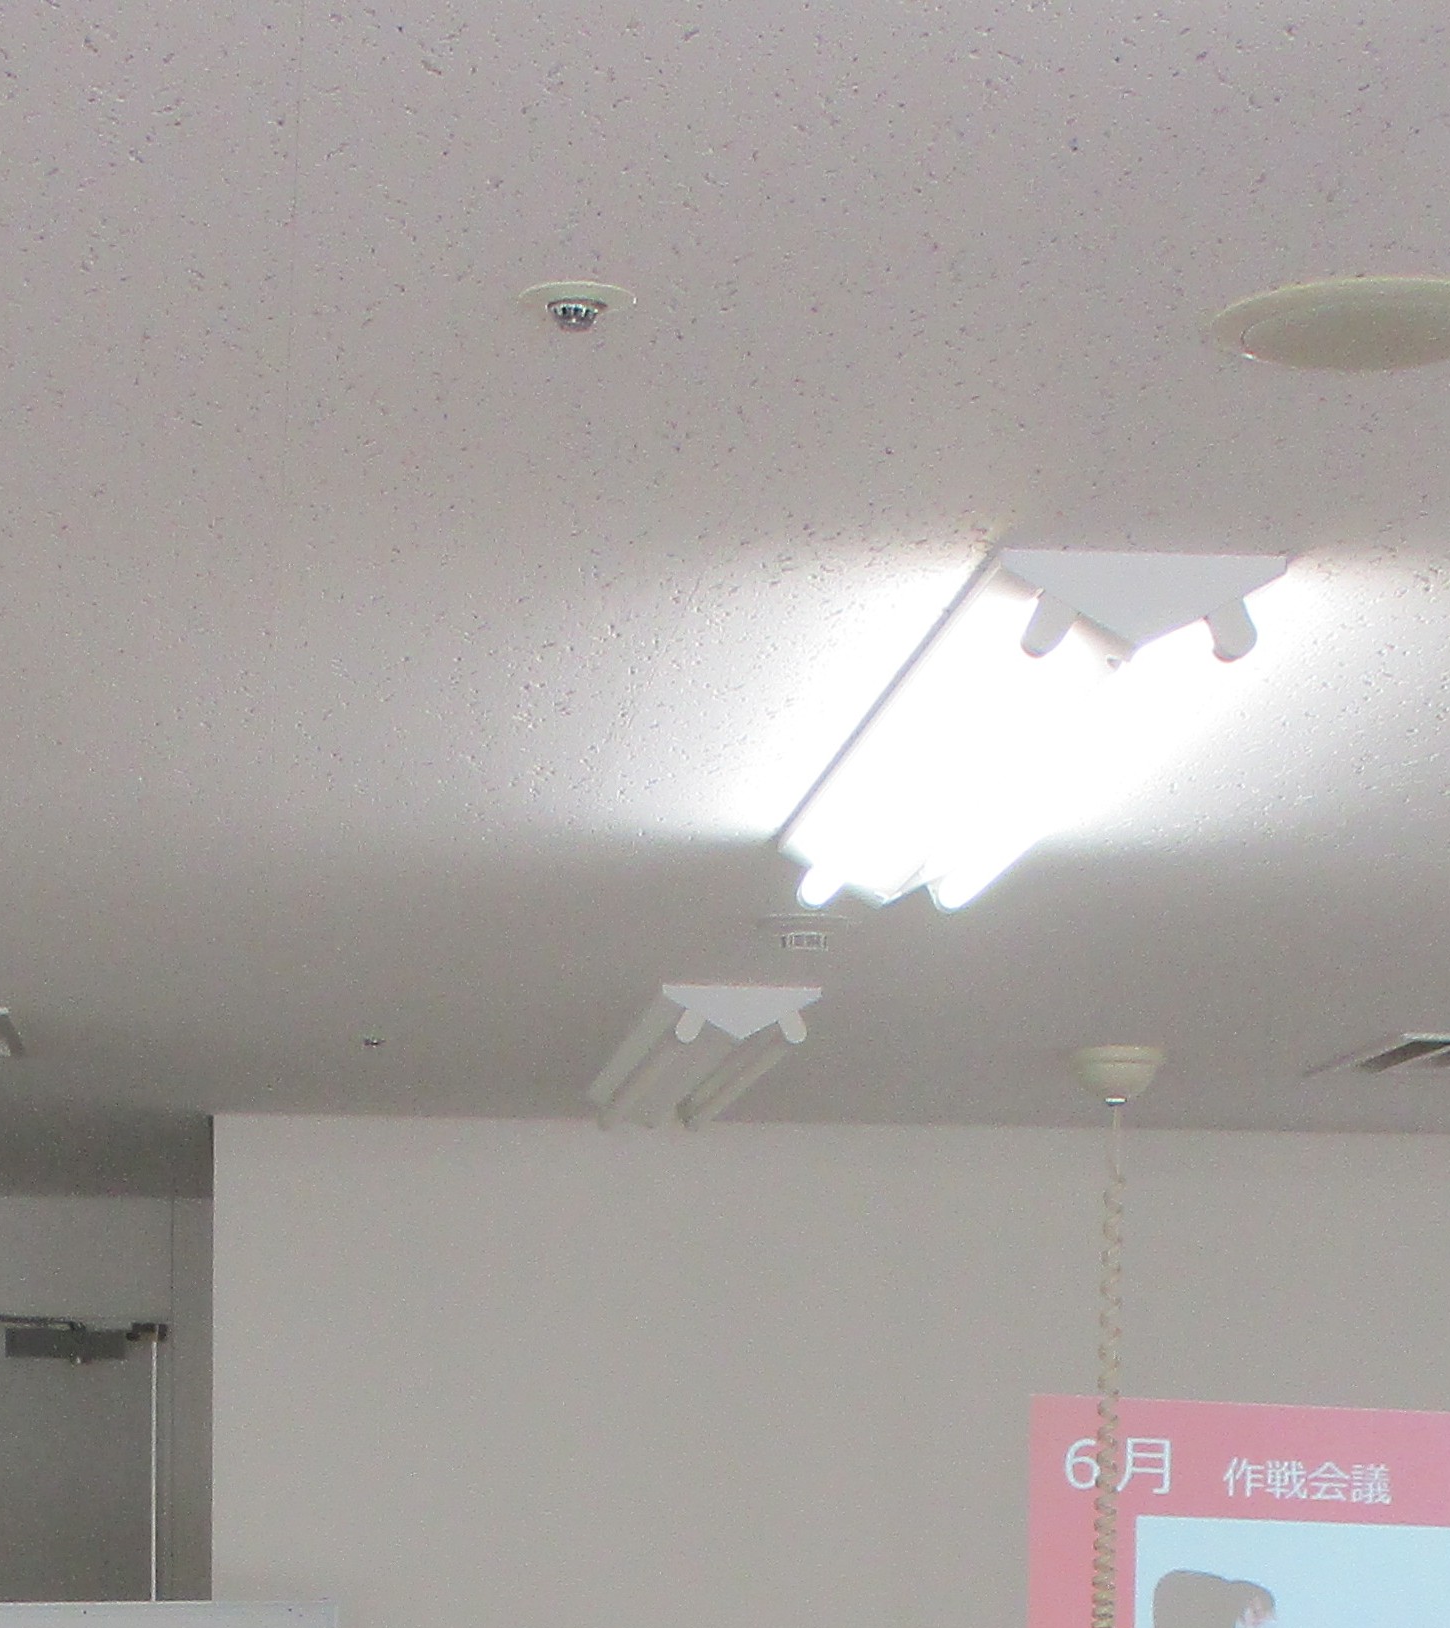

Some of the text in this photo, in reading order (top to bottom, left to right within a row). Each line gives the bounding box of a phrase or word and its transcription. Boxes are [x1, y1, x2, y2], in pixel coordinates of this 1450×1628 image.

[1063, 1436, 1393, 1506] 6月 作戦会議
